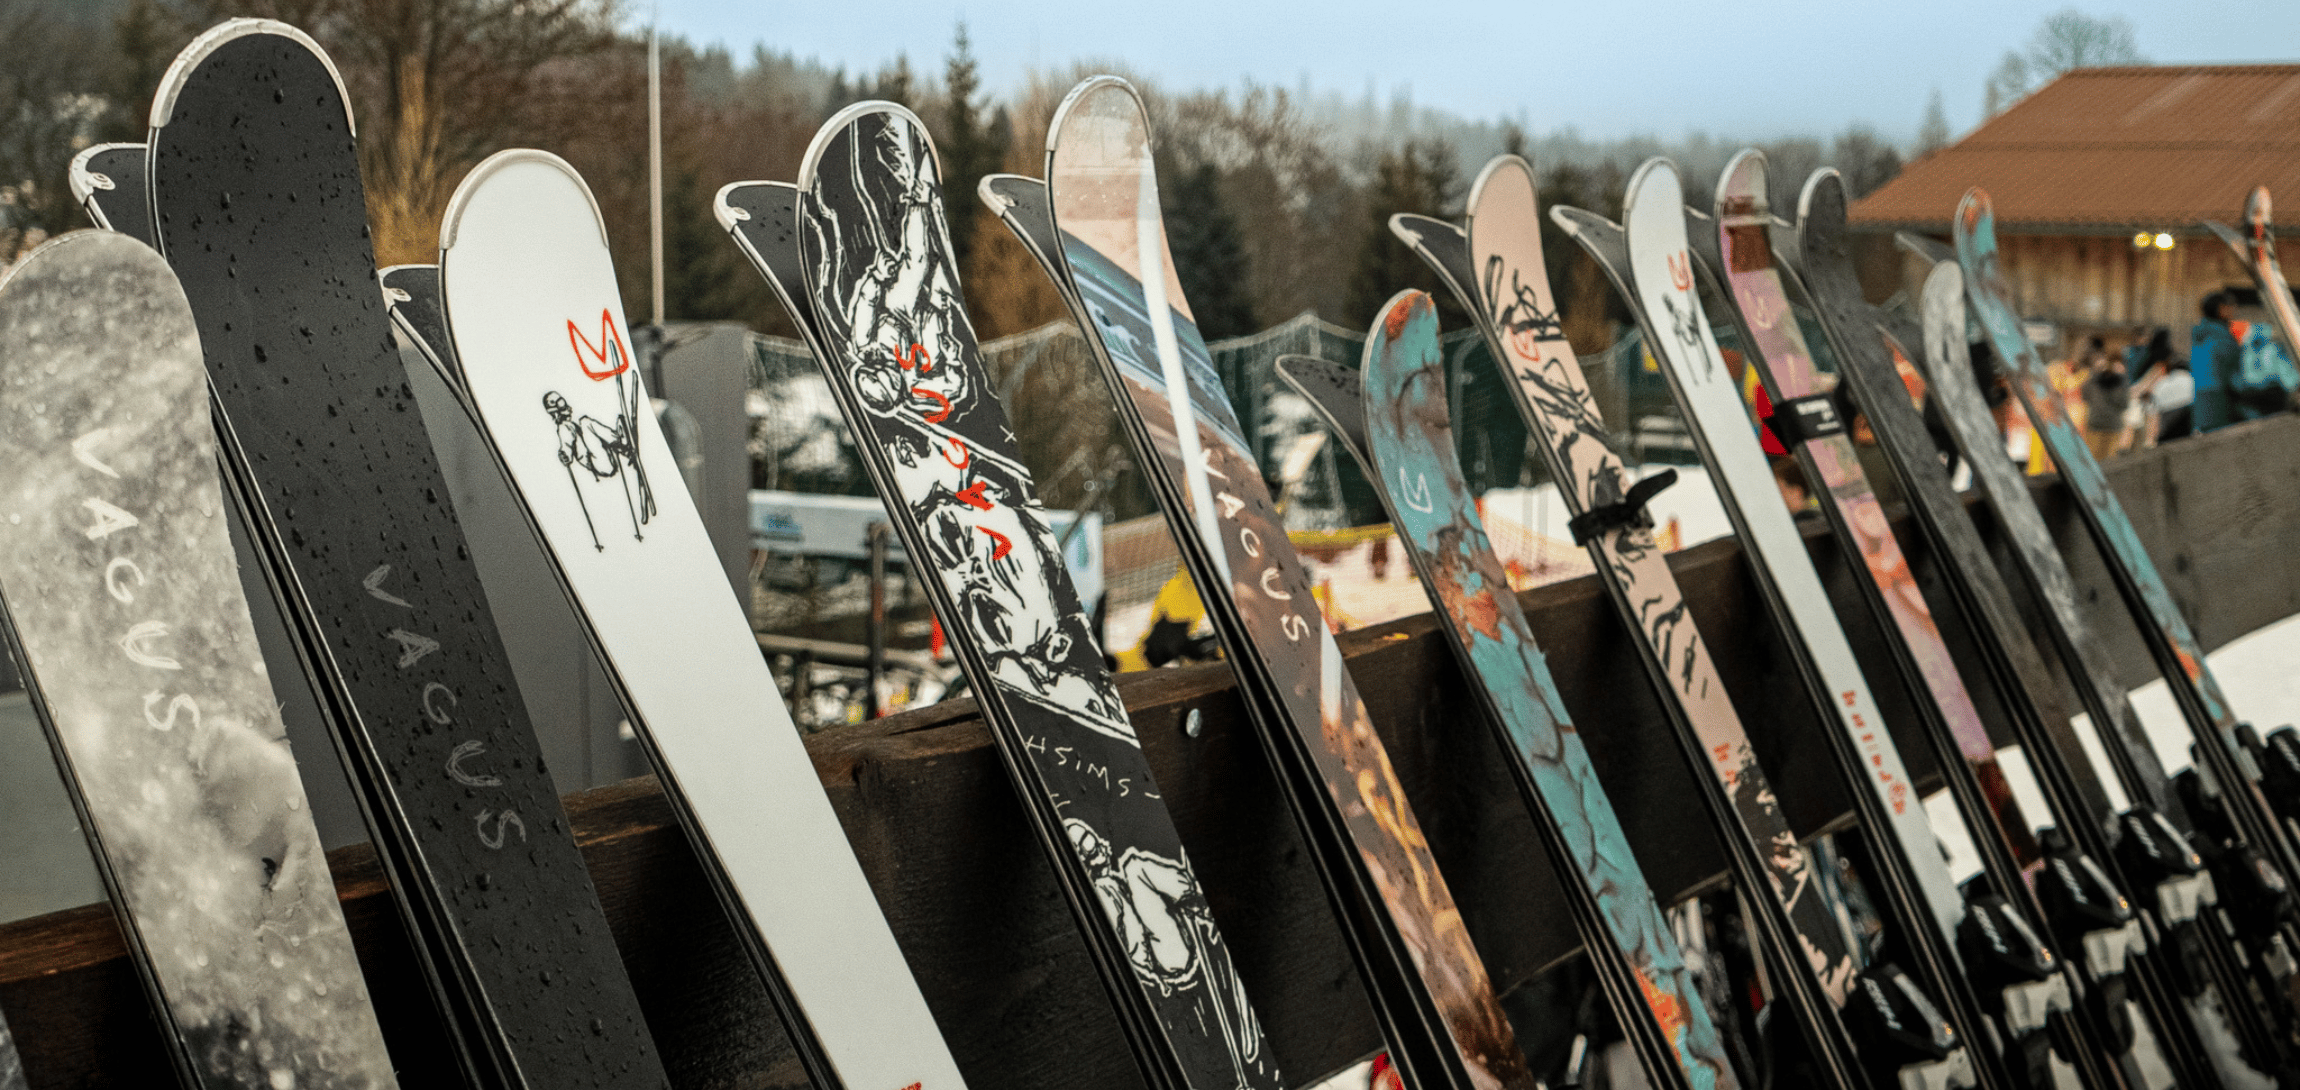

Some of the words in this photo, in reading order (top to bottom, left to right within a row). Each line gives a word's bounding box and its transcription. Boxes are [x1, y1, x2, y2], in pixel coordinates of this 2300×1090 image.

[894, 342, 1013, 560] VAGUS
[1199, 448, 1311, 642] VAGUS
[73, 427, 201, 731] VAGUS
[362, 564, 527, 849] VAGUS
